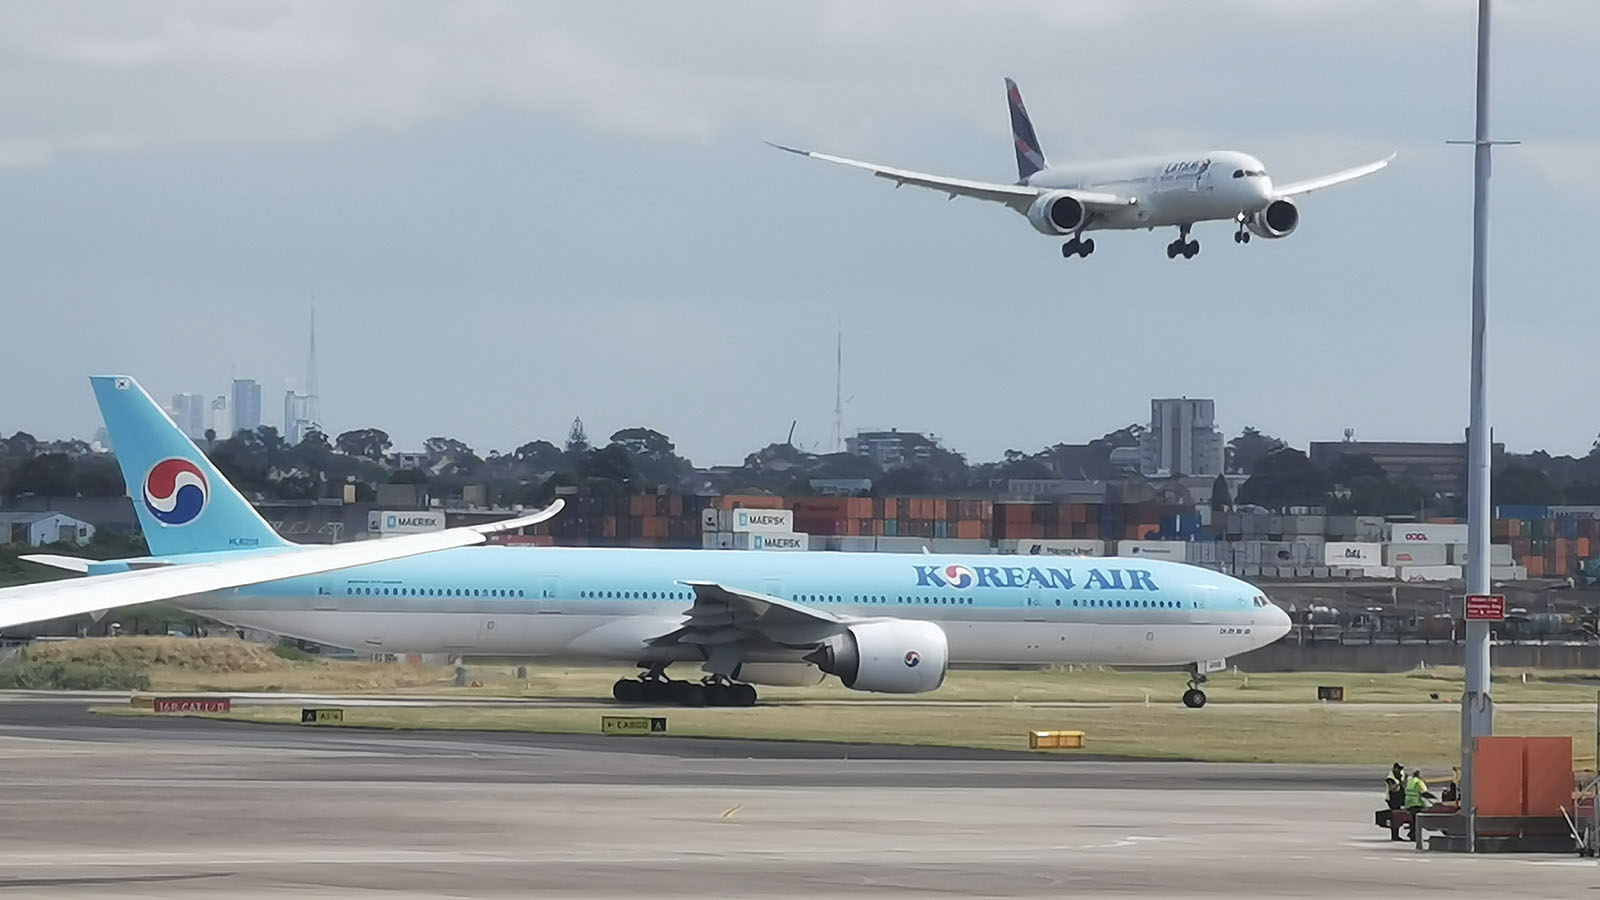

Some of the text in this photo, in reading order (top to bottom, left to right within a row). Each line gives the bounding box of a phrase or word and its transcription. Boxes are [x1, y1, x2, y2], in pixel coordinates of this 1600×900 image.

[399, 517, 437, 527] MAERSK
[750, 515, 785, 525] MAERSK
[764, 538, 801, 548] MAERSK
[913, 565, 1160, 591] KOREAN AIR
[616, 721, 648, 729] CARGO
